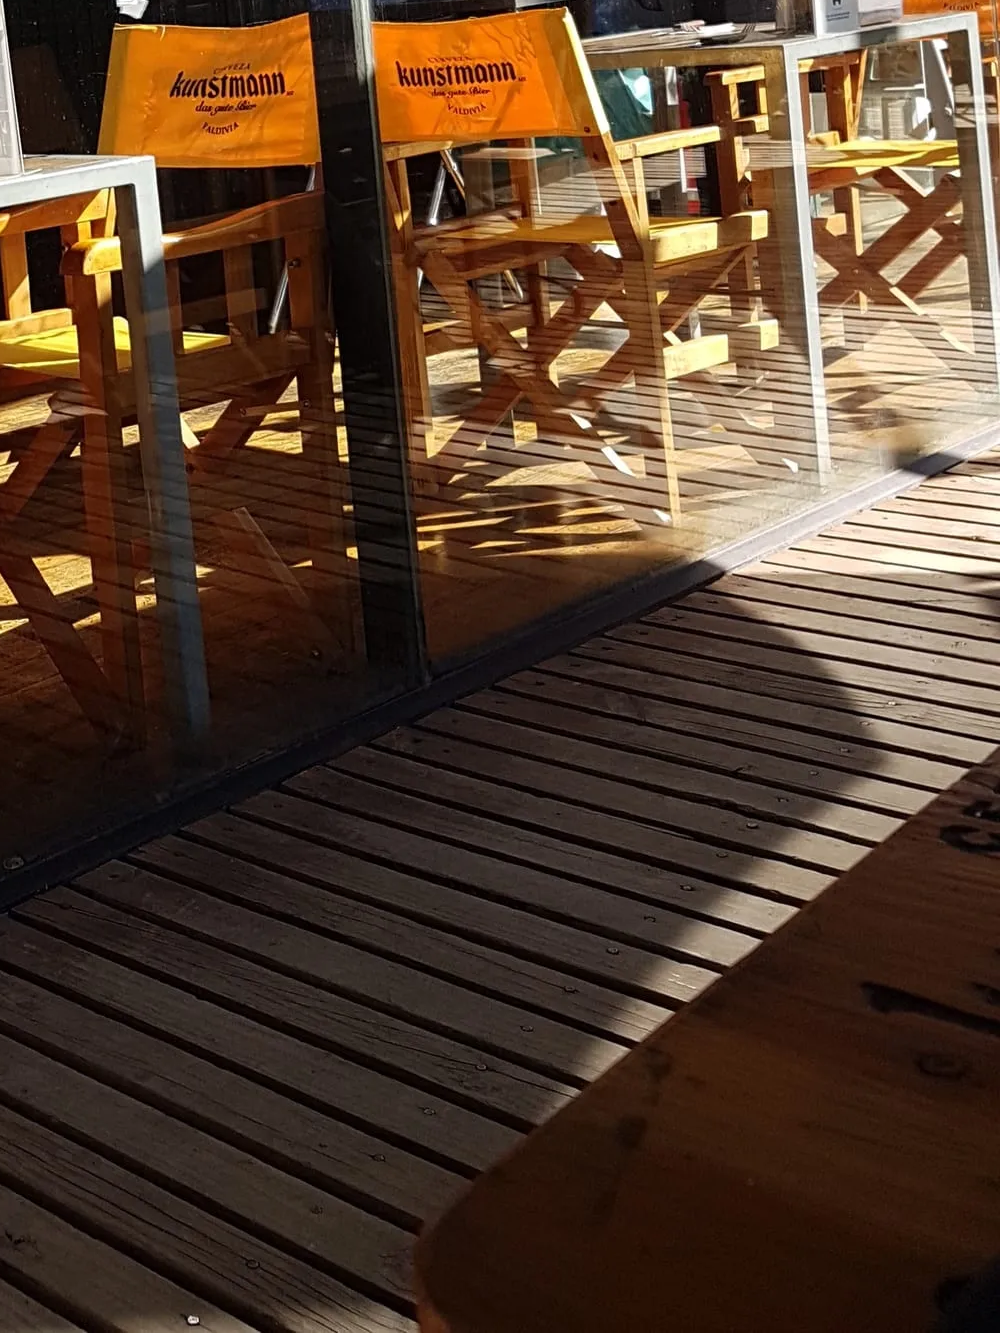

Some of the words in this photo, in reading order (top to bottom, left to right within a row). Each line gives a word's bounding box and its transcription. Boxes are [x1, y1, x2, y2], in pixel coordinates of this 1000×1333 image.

[395, 60, 516, 87] kunstmann
[169, 70, 286, 98] kunstmann
[447, 103, 486, 115] VALDIVIA
[202, 121, 239, 135] VALDIVIA
